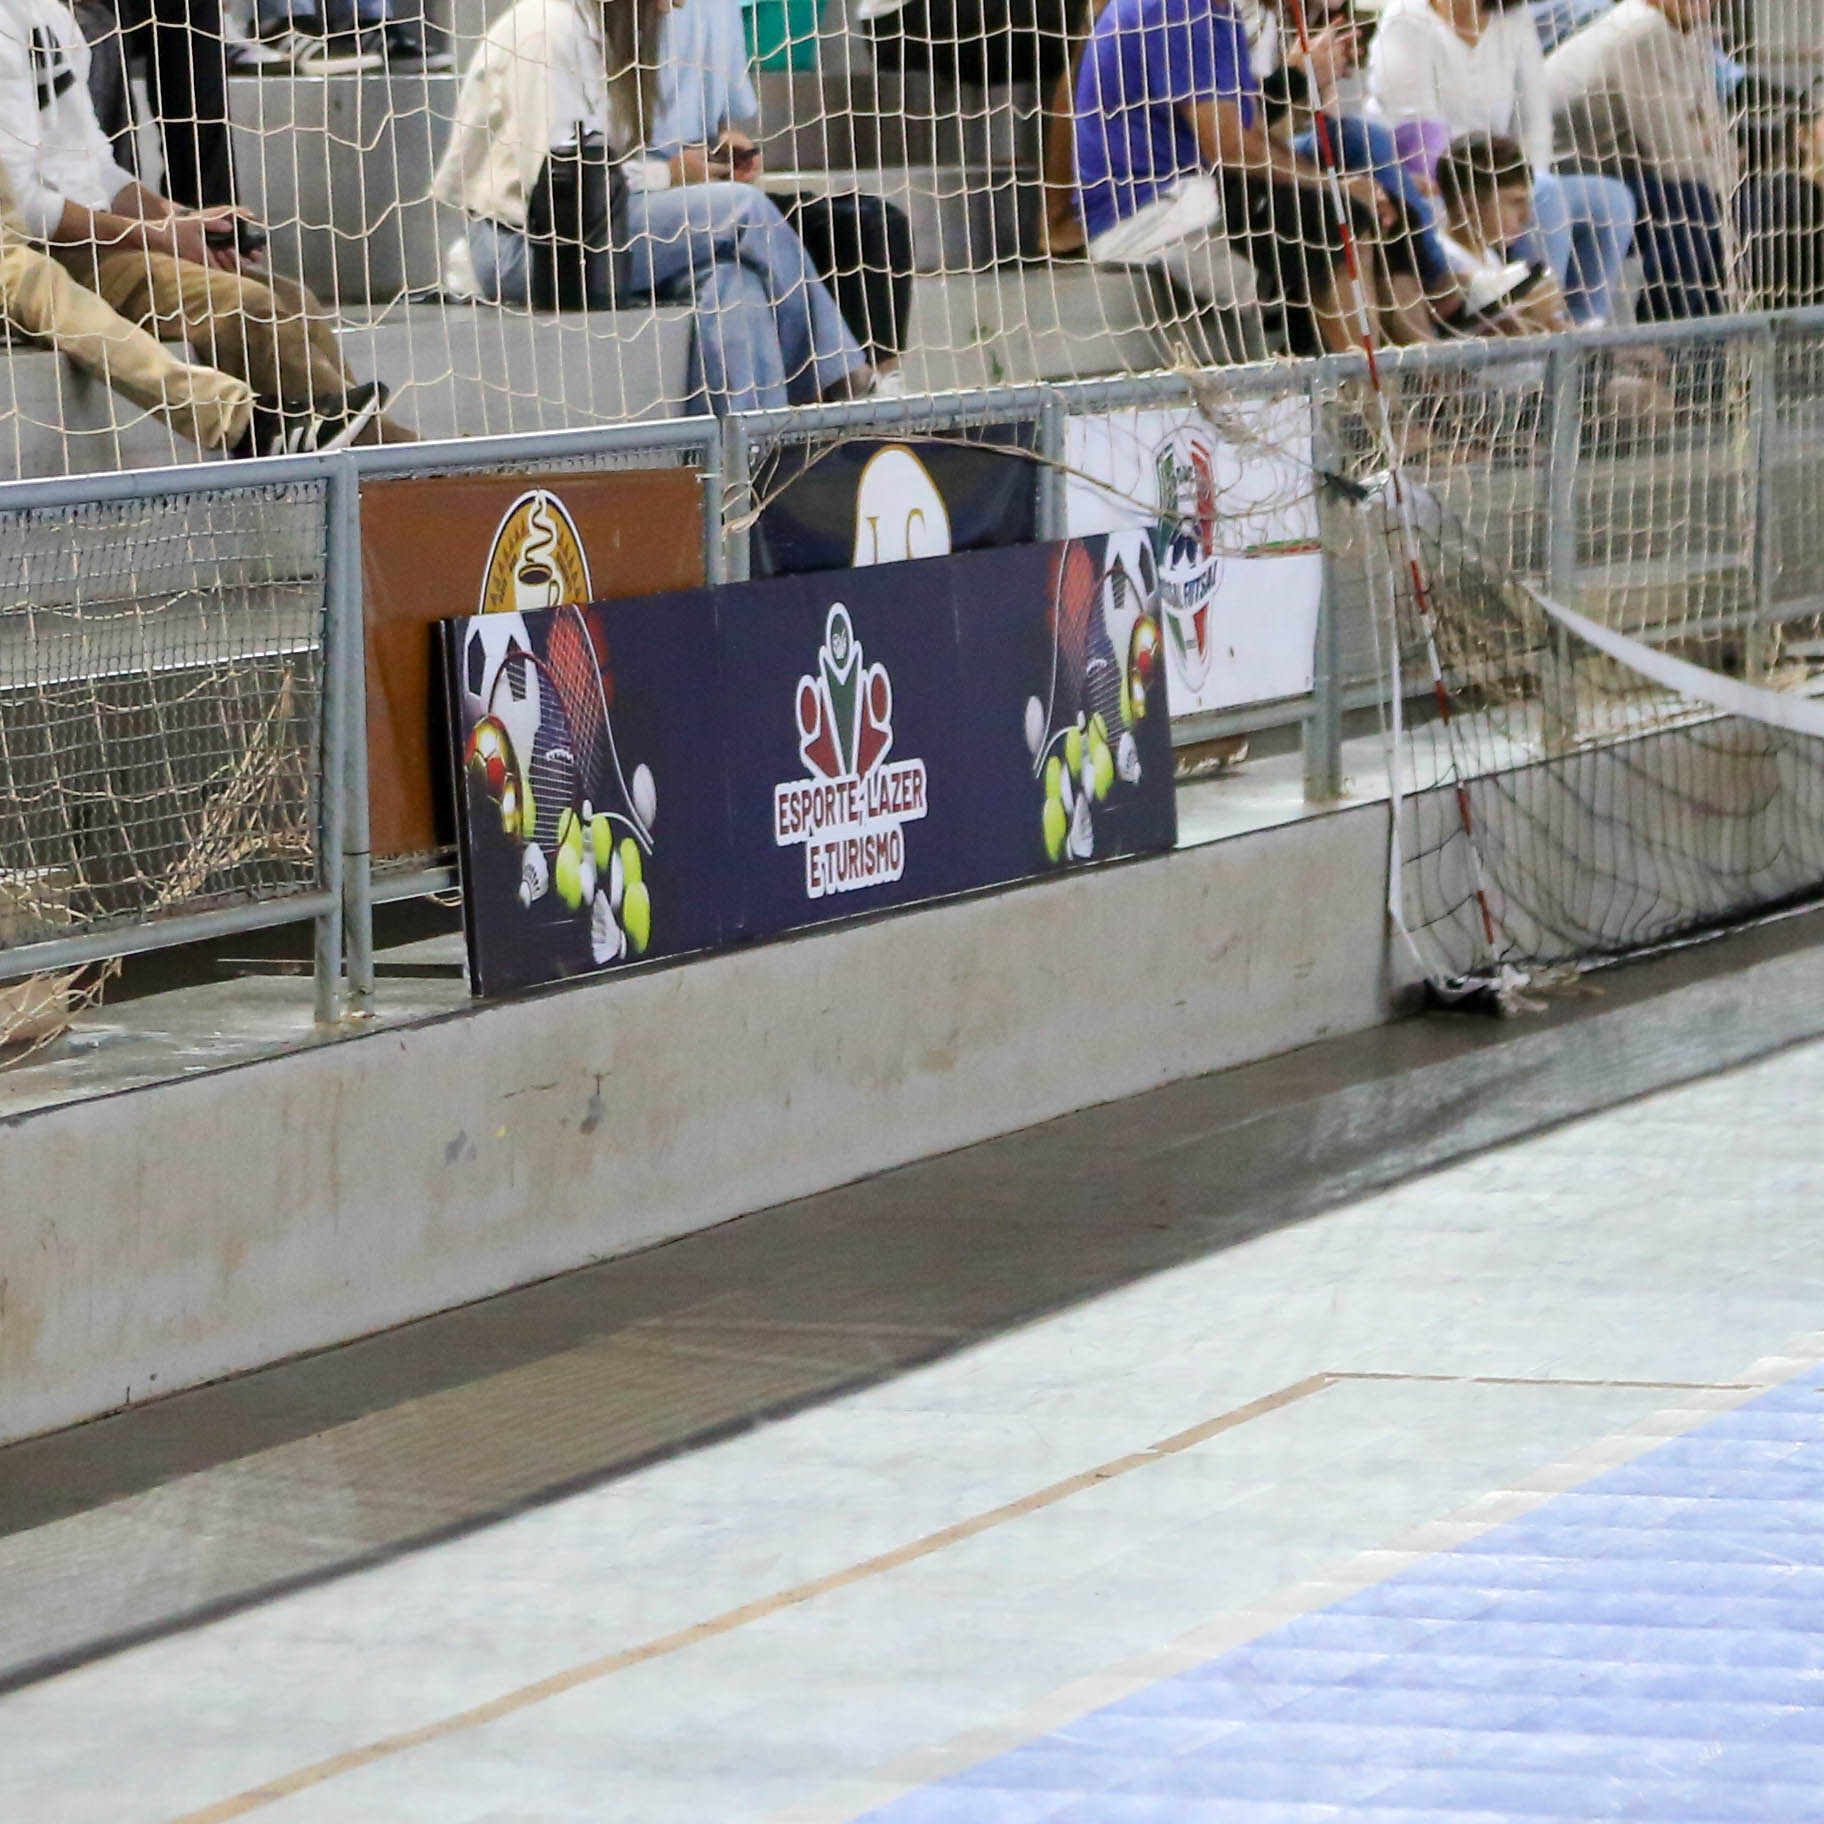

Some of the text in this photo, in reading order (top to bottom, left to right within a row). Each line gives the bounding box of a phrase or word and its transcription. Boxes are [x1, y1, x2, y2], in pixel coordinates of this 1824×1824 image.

[868, 768, 924, 818] LAZER
[810, 829, 902, 888] E TURISMO
